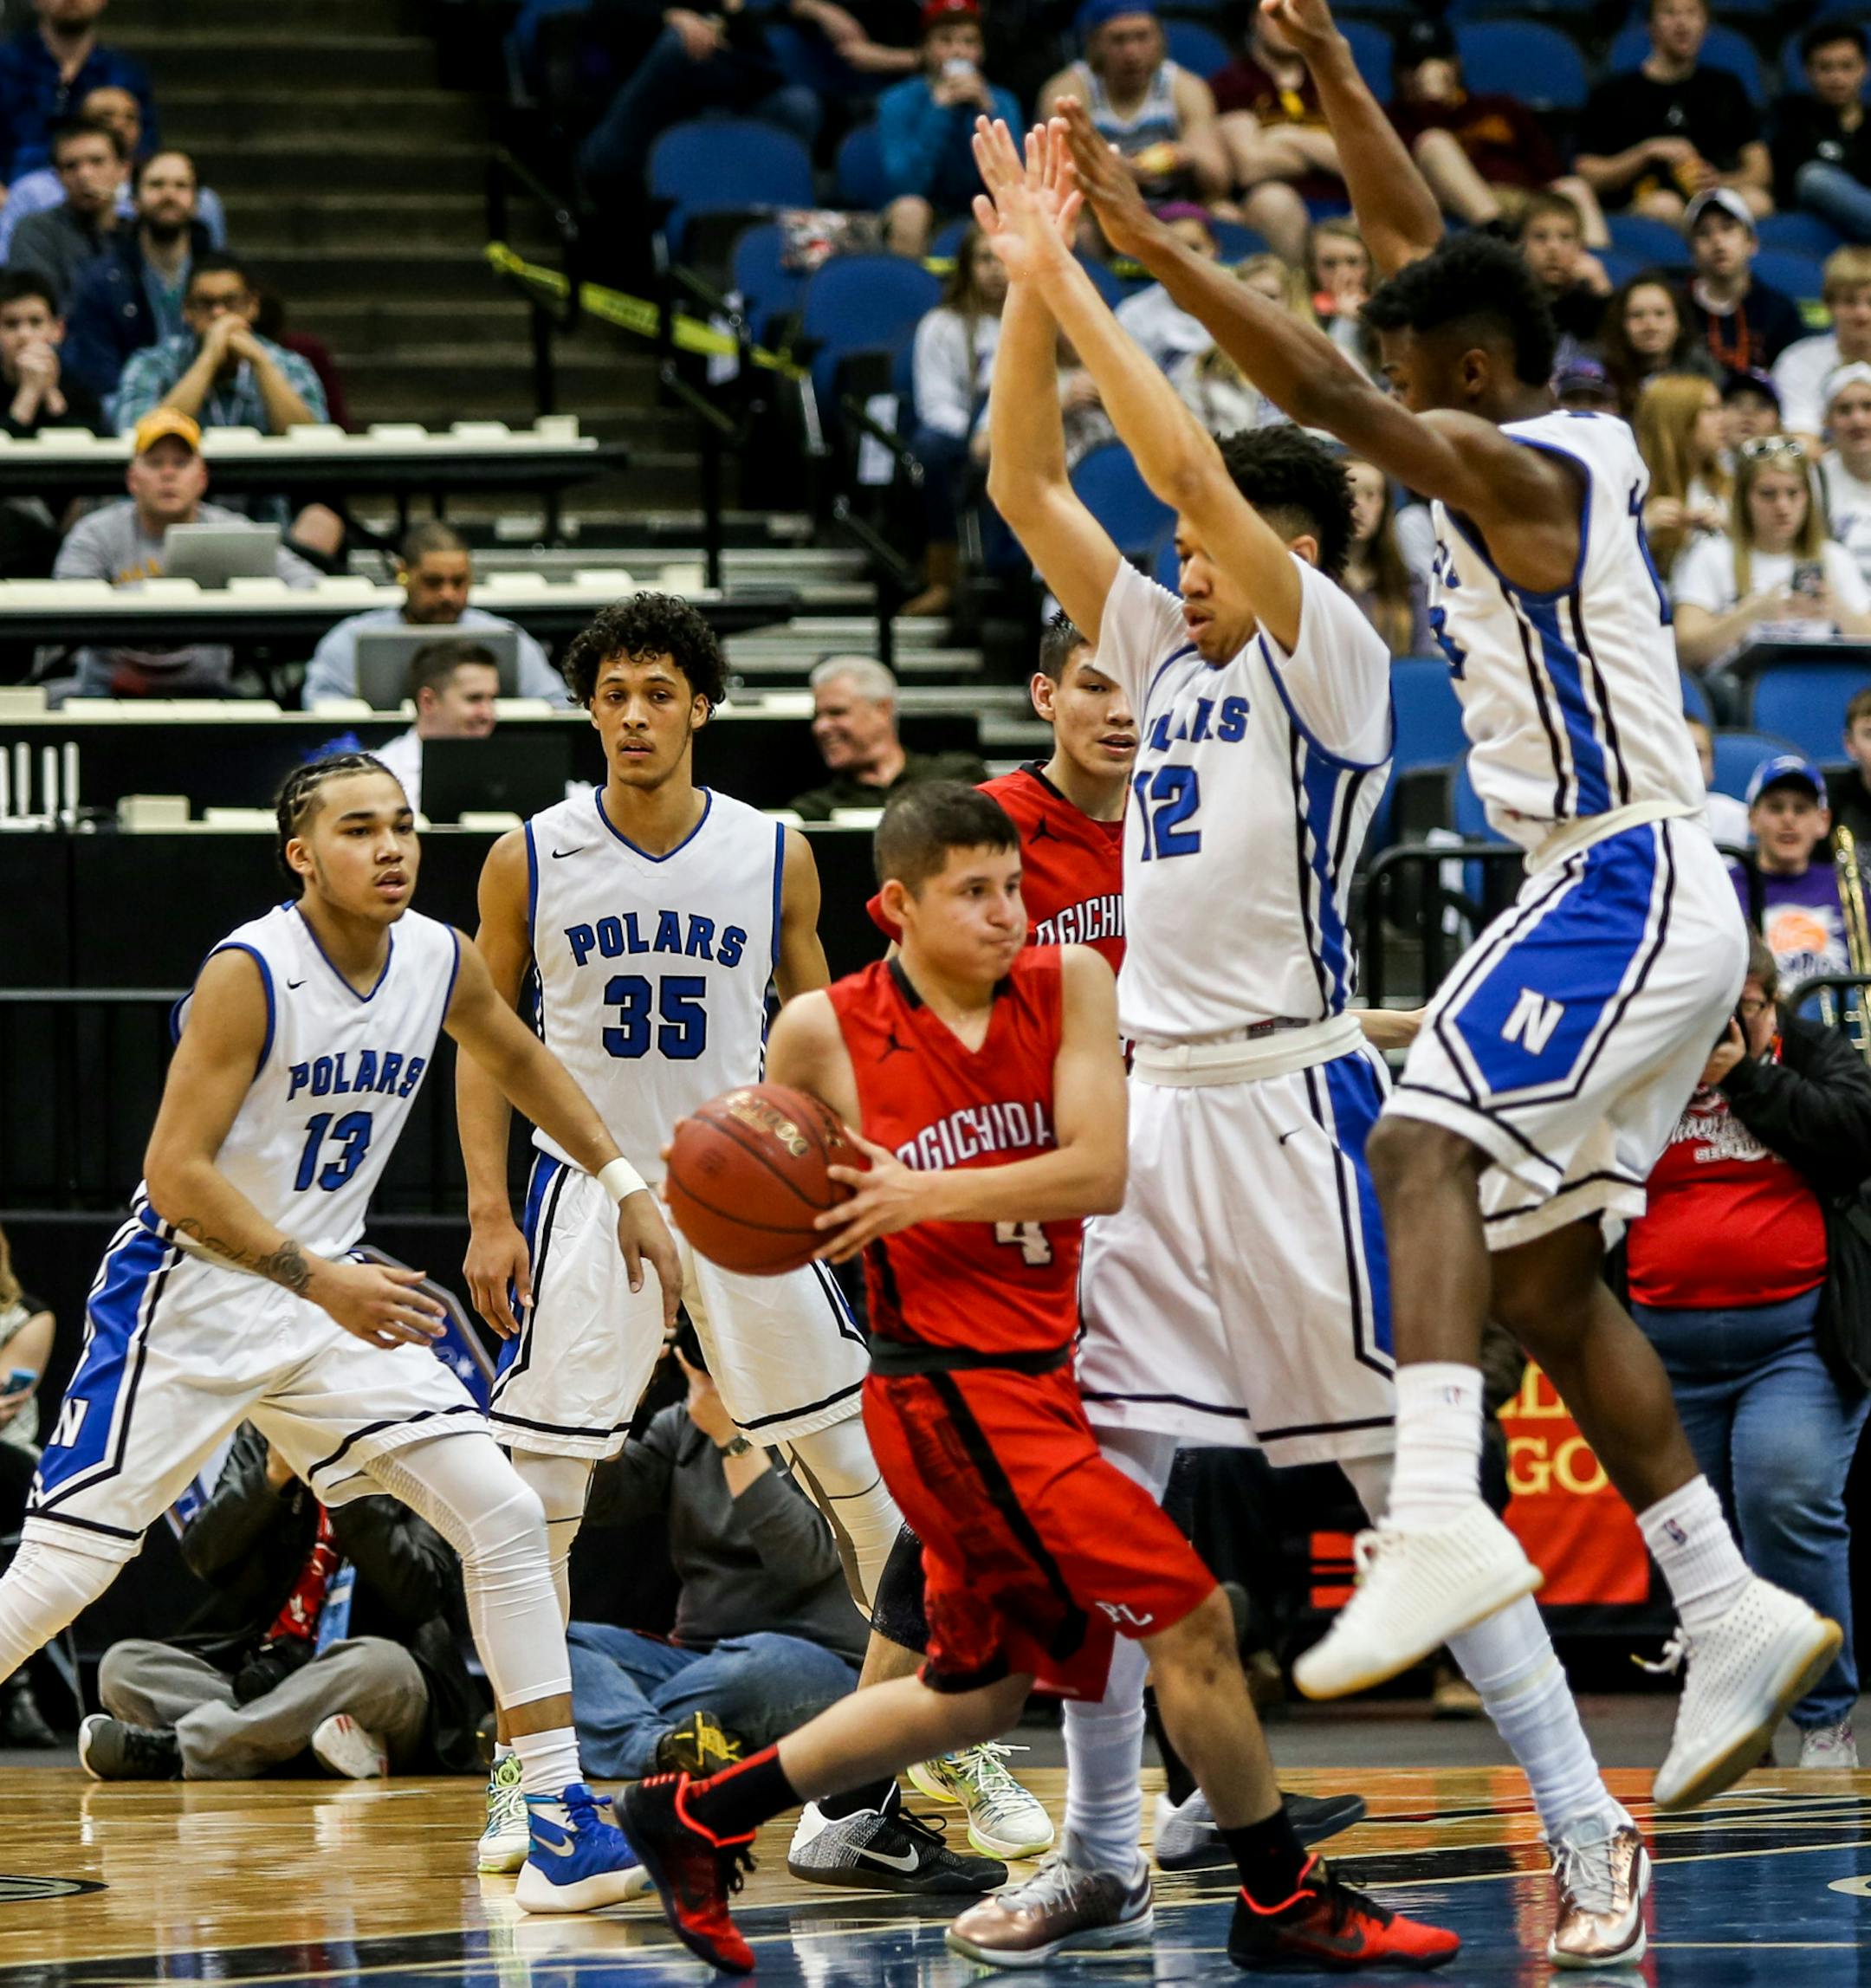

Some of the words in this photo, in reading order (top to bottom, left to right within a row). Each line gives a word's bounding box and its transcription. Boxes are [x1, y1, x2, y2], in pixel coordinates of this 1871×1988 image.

[564, 910, 748, 968] POLARS
[603, 975, 707, 1059] 35
[1500, 987, 1565, 1056] N
[286, 1049, 425, 1102] POLARS
[293, 1111, 373, 1192] 13
[994, 1221, 1052, 1265] 4
[48, 1396, 90, 1448] N
